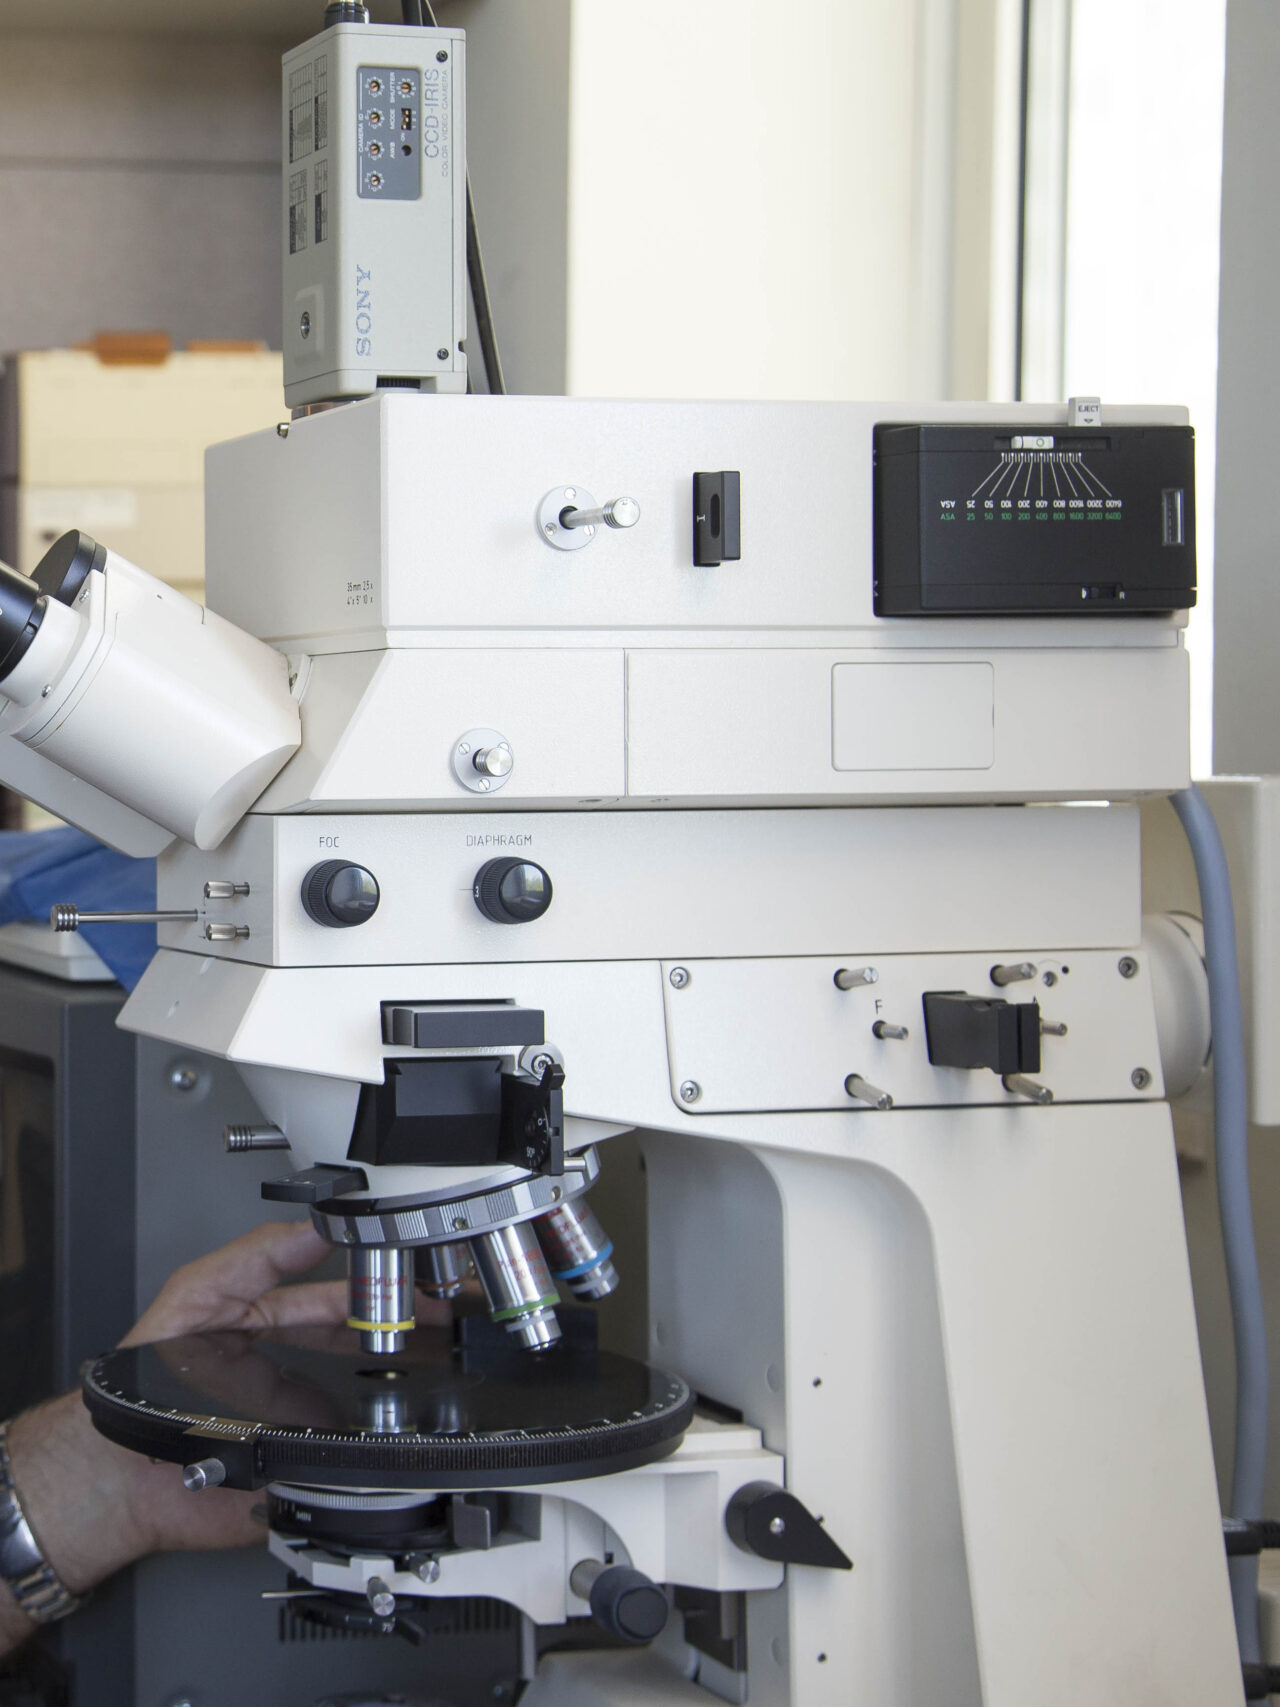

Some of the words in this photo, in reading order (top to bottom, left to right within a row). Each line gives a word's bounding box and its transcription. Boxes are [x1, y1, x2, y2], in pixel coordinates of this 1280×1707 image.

[358, 113, 364, 121] ID
[424, 68, 439, 158] CCD-IRIS
[356, 263, 371, 357] SONY
[1077, 404, 1099, 413] EJECT
[940, 499, 956, 509] ASA
[940, 511, 956, 521] ASA
[984, 511, 994, 521] 50
[1000, 511, 1012, 521] 100
[1017, 511, 1031, 521] 200
[319, 836, 340, 848] FOC
[466, 834, 532, 847] DIAPHRAGM
[874, 999, 883, 1015] F
